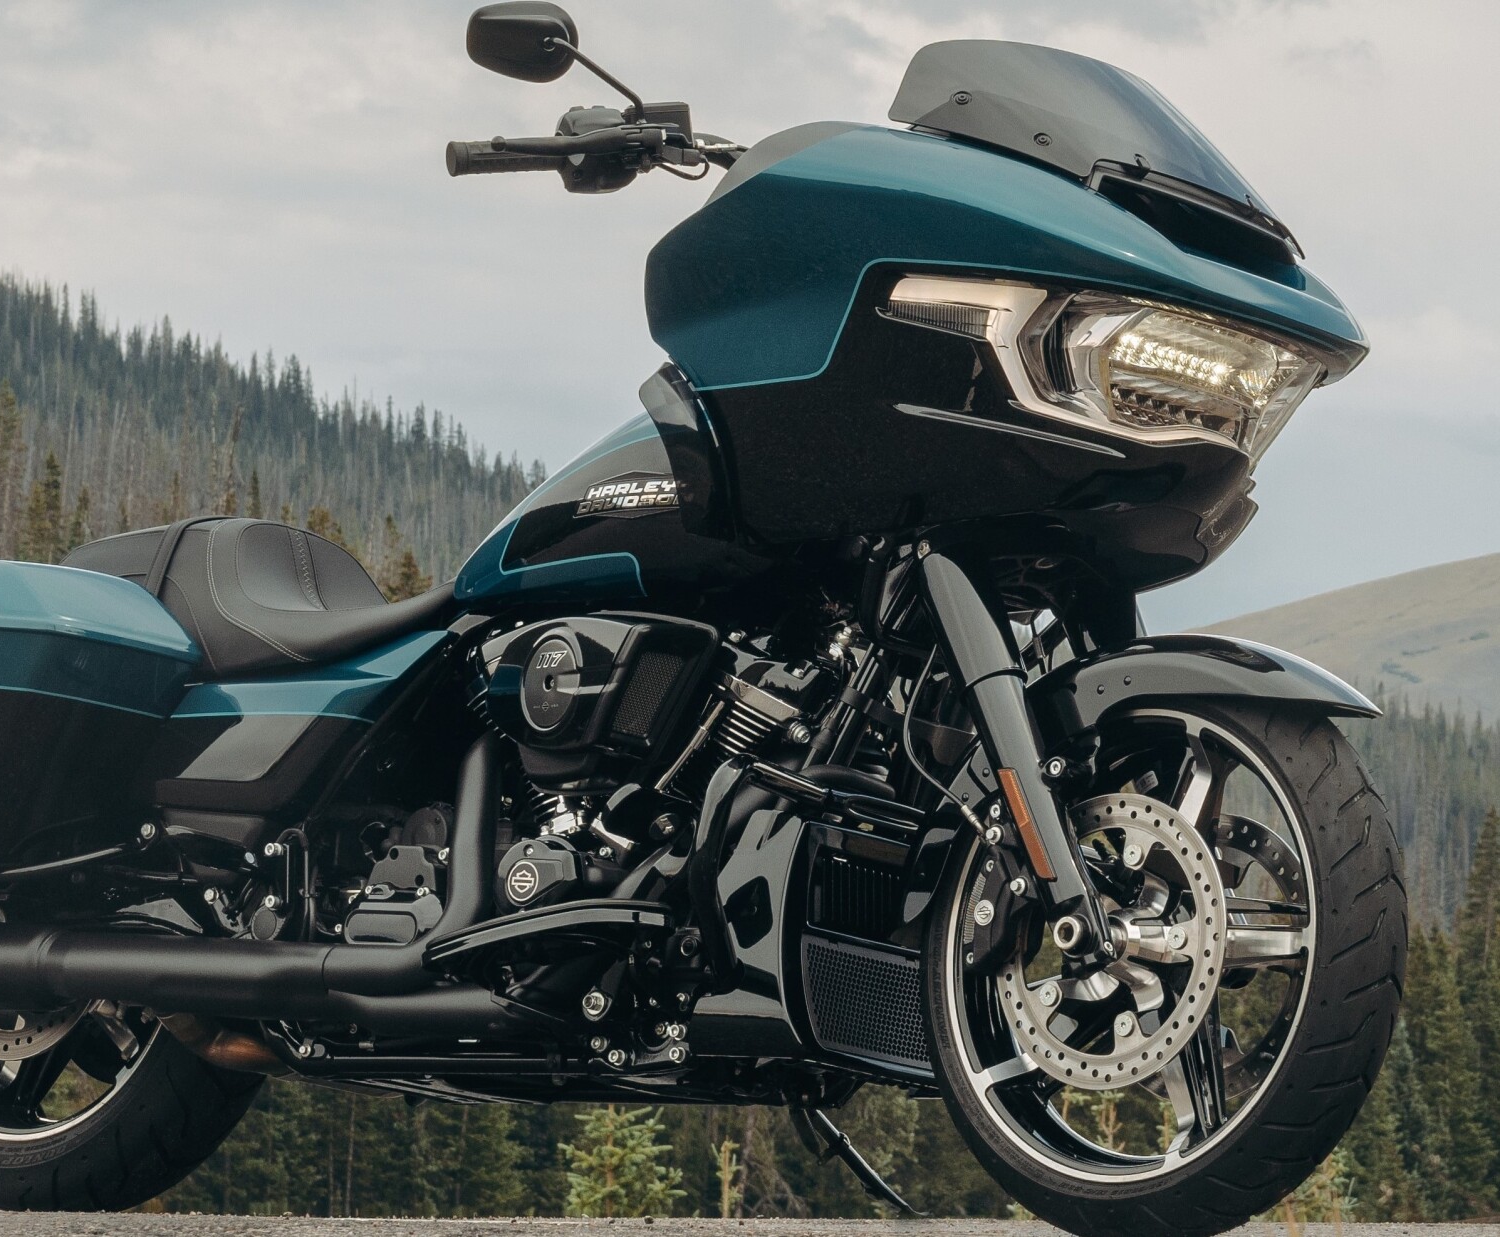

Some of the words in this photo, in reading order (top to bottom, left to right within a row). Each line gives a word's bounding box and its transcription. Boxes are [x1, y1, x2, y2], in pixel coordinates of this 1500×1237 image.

[587, 480, 677, 499] HARLEY
[535, 650, 568, 669] 117
[1, 1144, 67, 1165] DUNLOP
